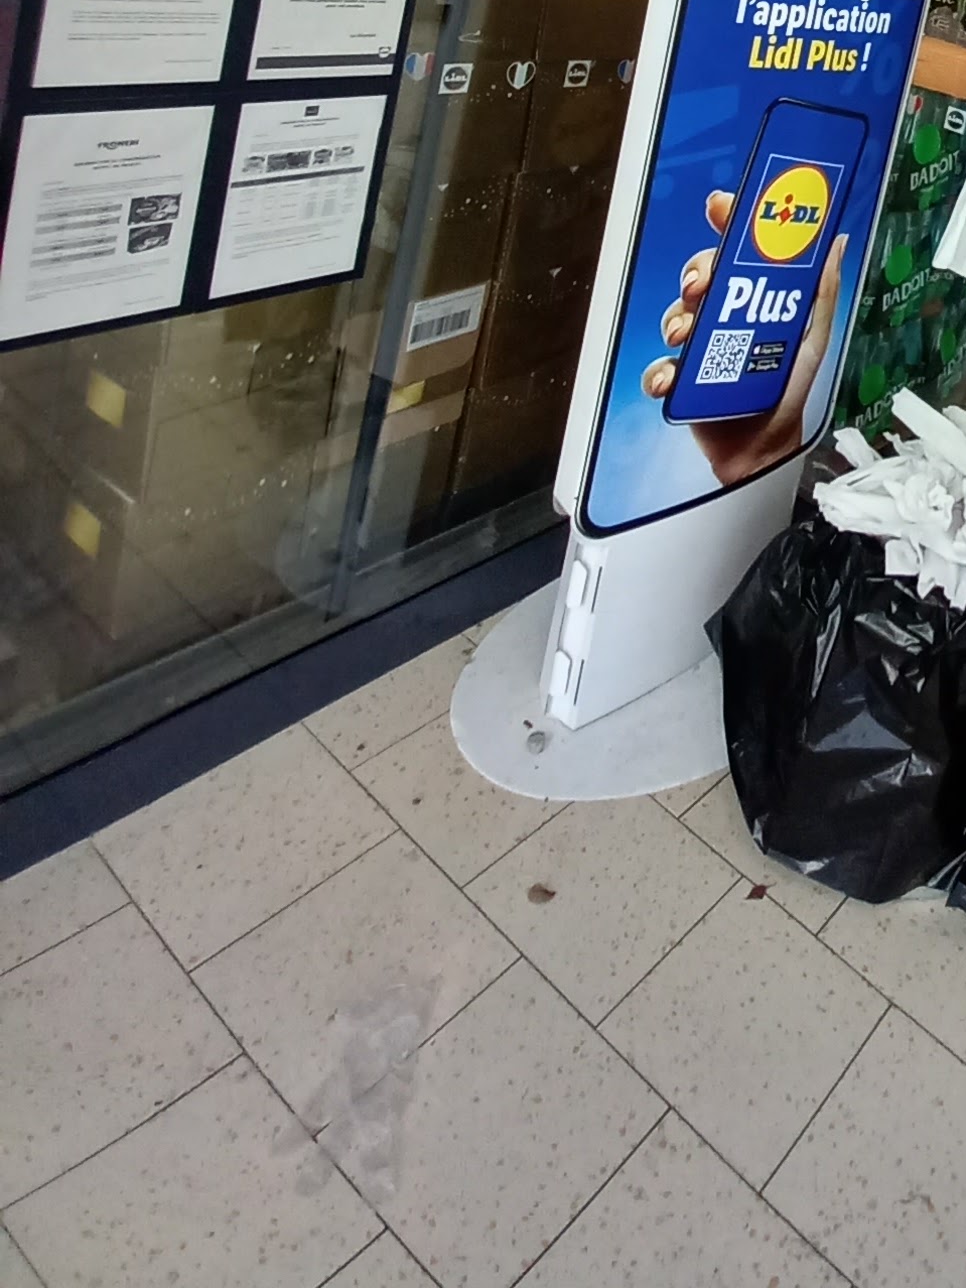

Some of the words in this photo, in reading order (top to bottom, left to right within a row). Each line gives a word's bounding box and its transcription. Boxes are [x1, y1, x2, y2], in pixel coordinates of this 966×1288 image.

[748, 35, 804, 71] Lidl
[806, 39, 858, 72] Plus
[910, 150, 960, 191] BADOIT
[760, 194, 820, 226] LIDL
[718, 276, 802, 323] Plus
[882, 267, 931, 312] BADOIT
[855, 391, 895, 429] BADO
